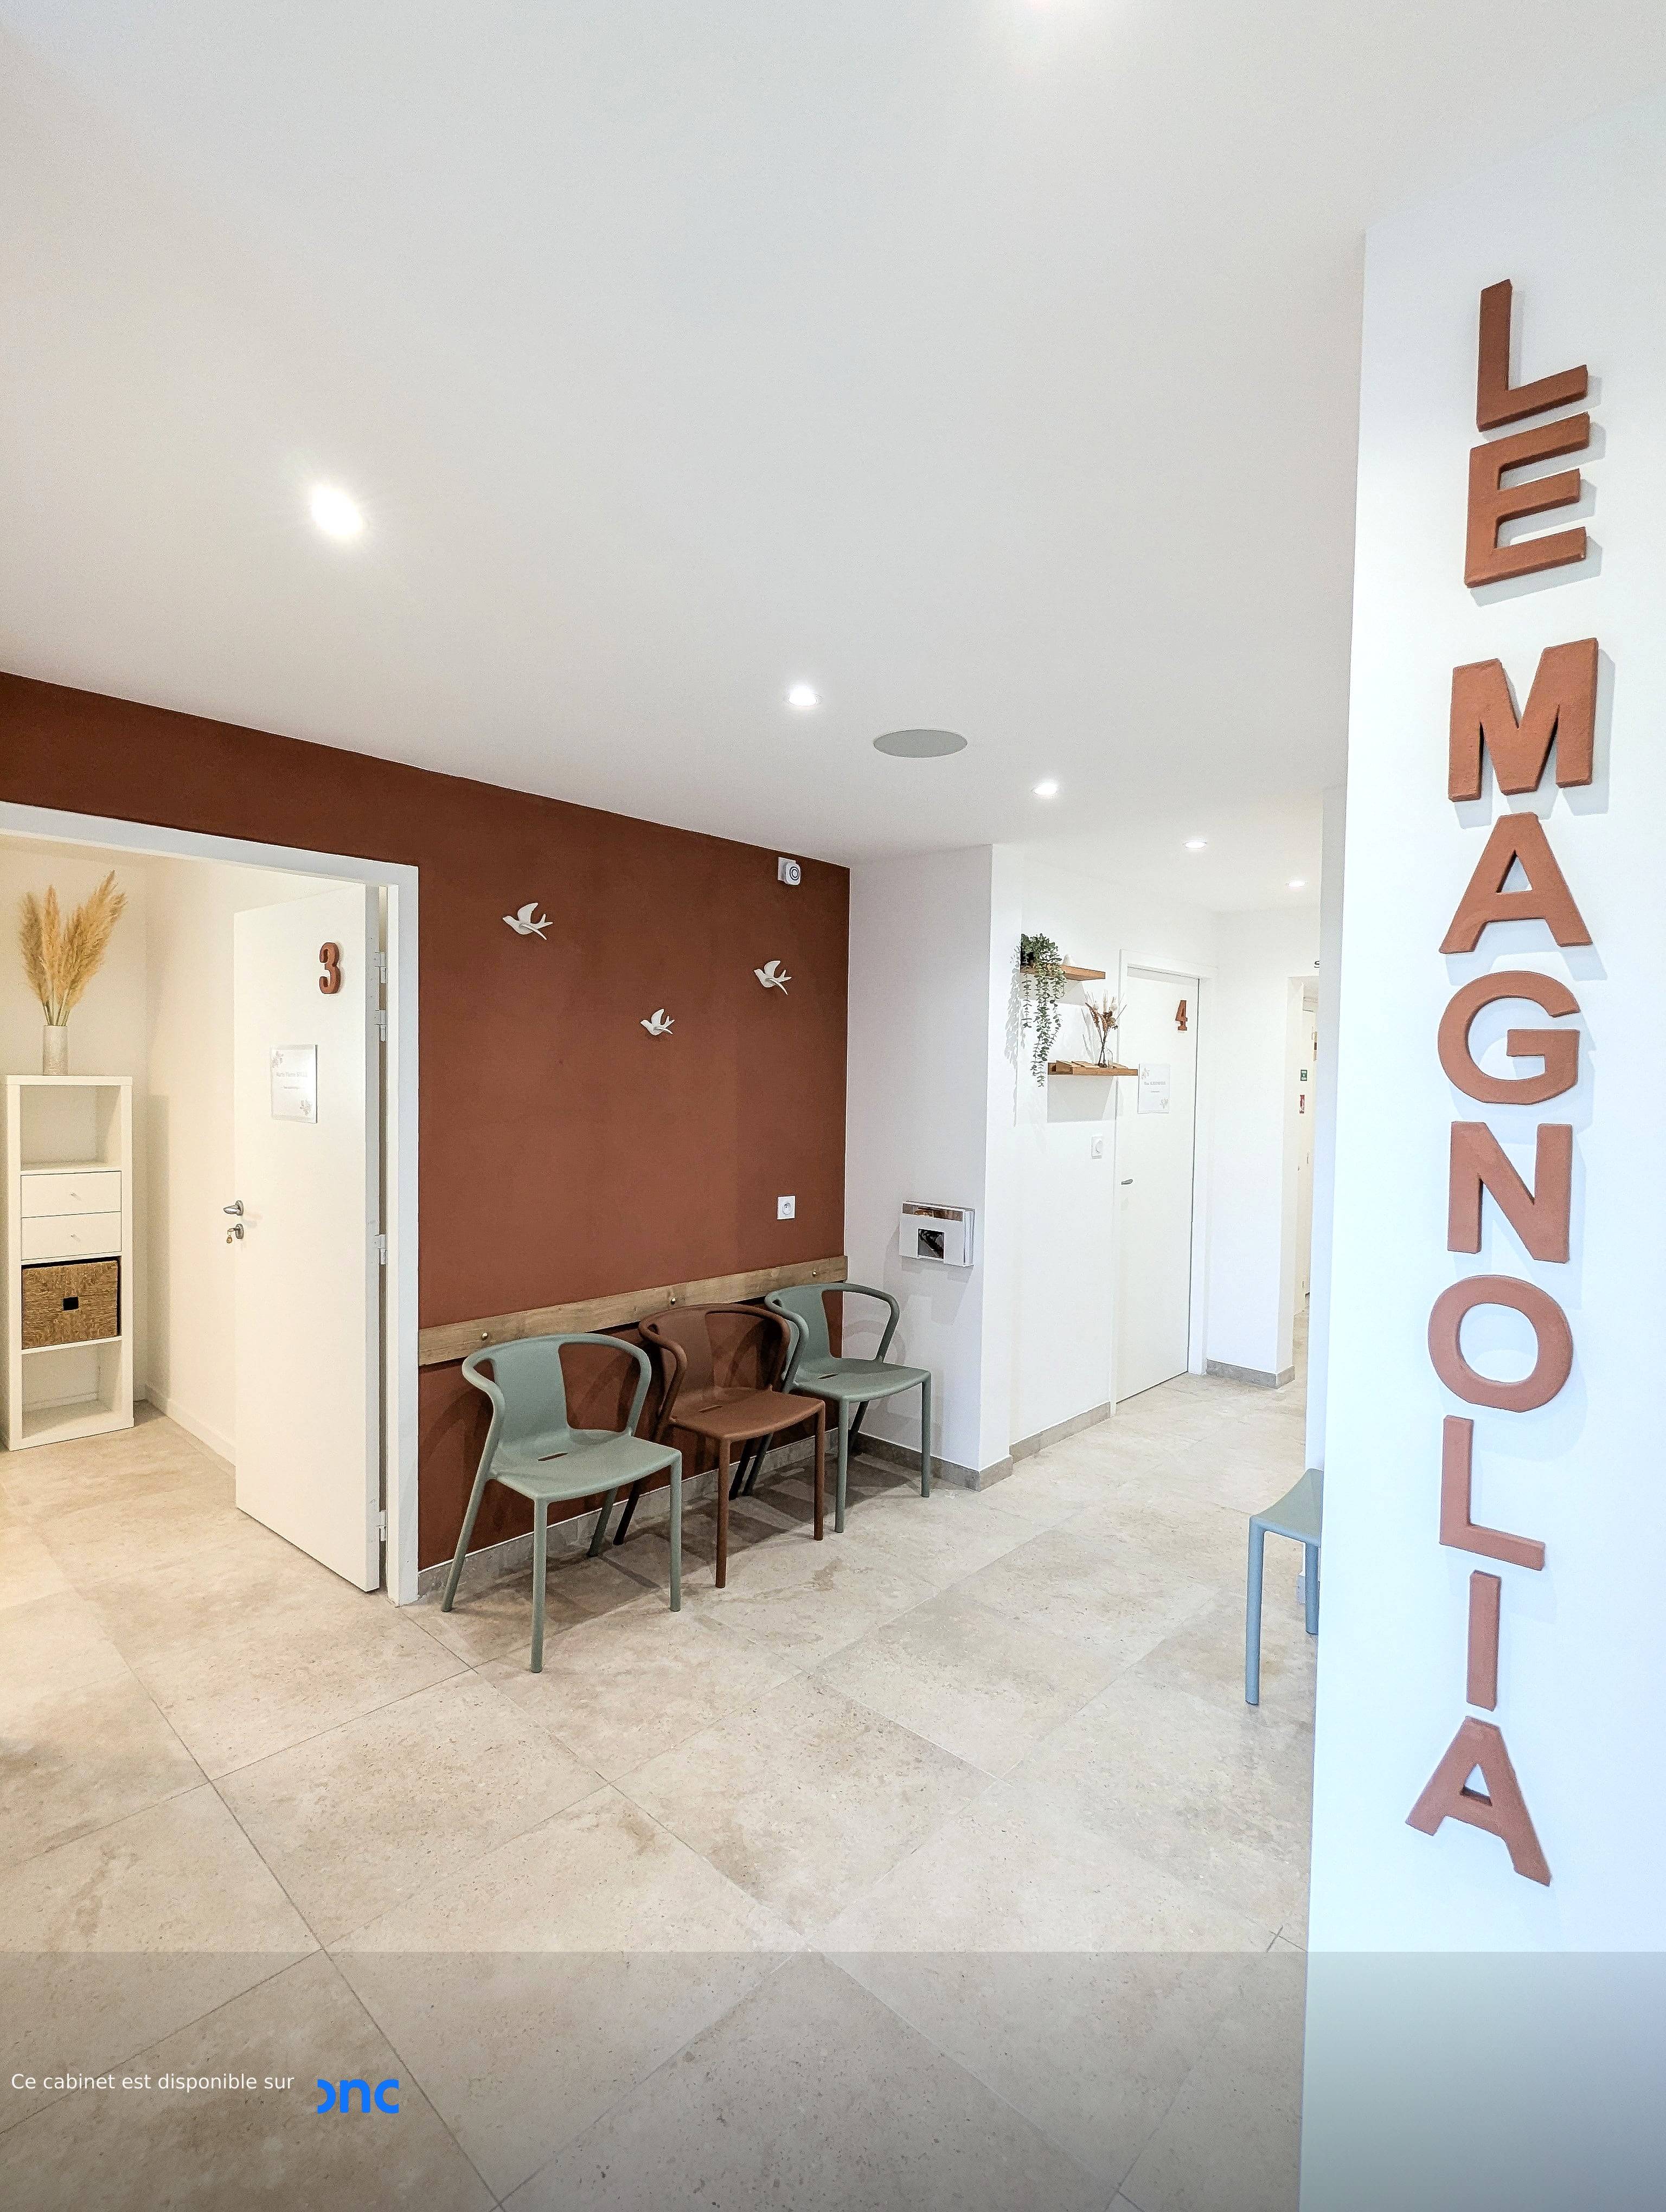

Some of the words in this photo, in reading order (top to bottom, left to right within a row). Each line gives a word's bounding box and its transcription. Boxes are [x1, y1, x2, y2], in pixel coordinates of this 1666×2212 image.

[1464, 278, 1590, 588] LE
[319, 942, 341, 994] 3
[1175, 1000, 1188, 1031] 4
[1406, 636, 1599, 1888] MAGNOLIA
